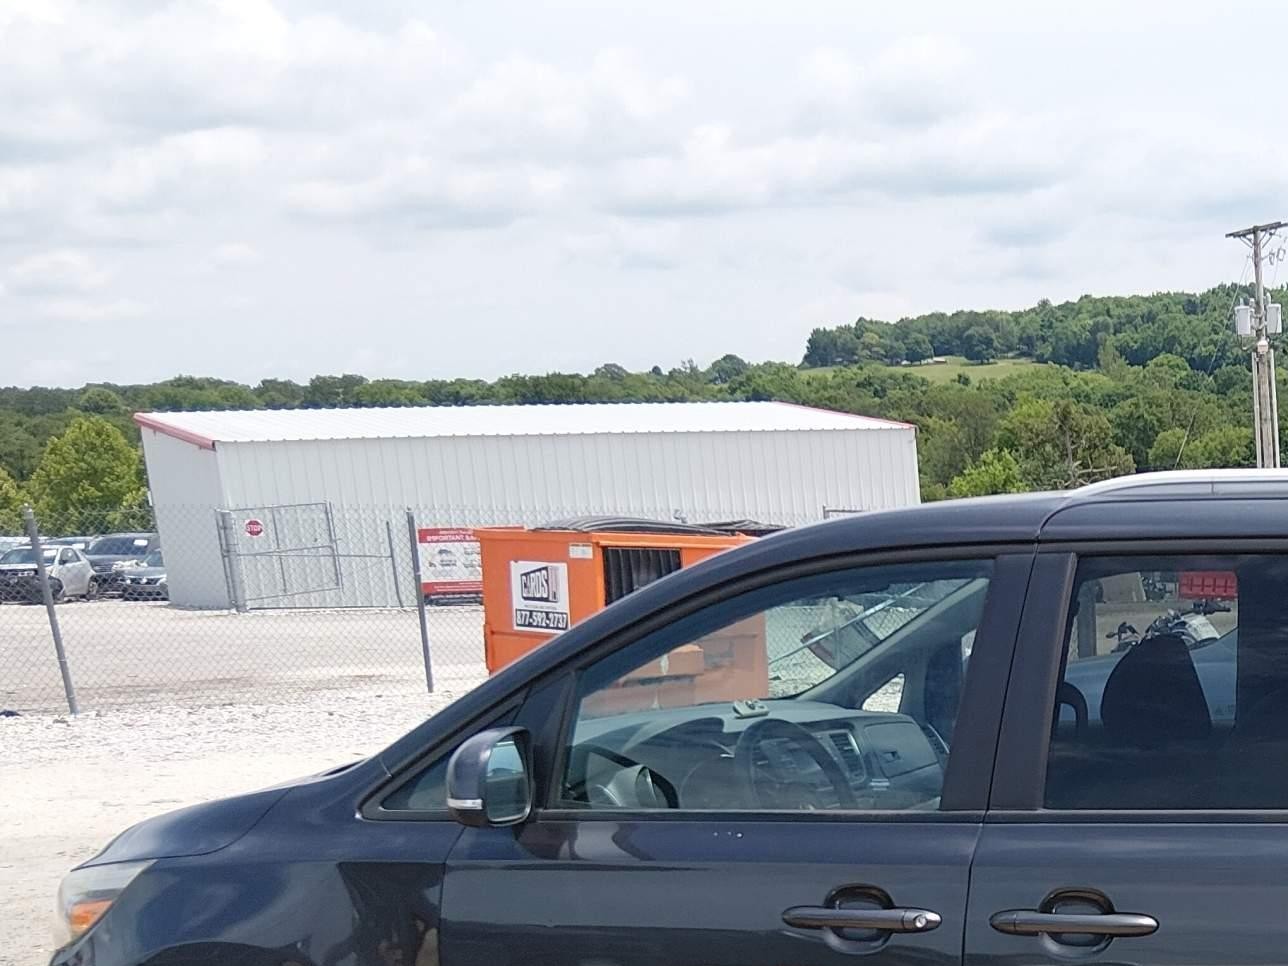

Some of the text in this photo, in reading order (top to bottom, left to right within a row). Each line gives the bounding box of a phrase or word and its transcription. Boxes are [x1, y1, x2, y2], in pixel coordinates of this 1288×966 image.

[246, 524, 262, 532] STOP
[521, 569, 549, 598] CARDS
[516, 610, 567, 629] 877-592-2737
